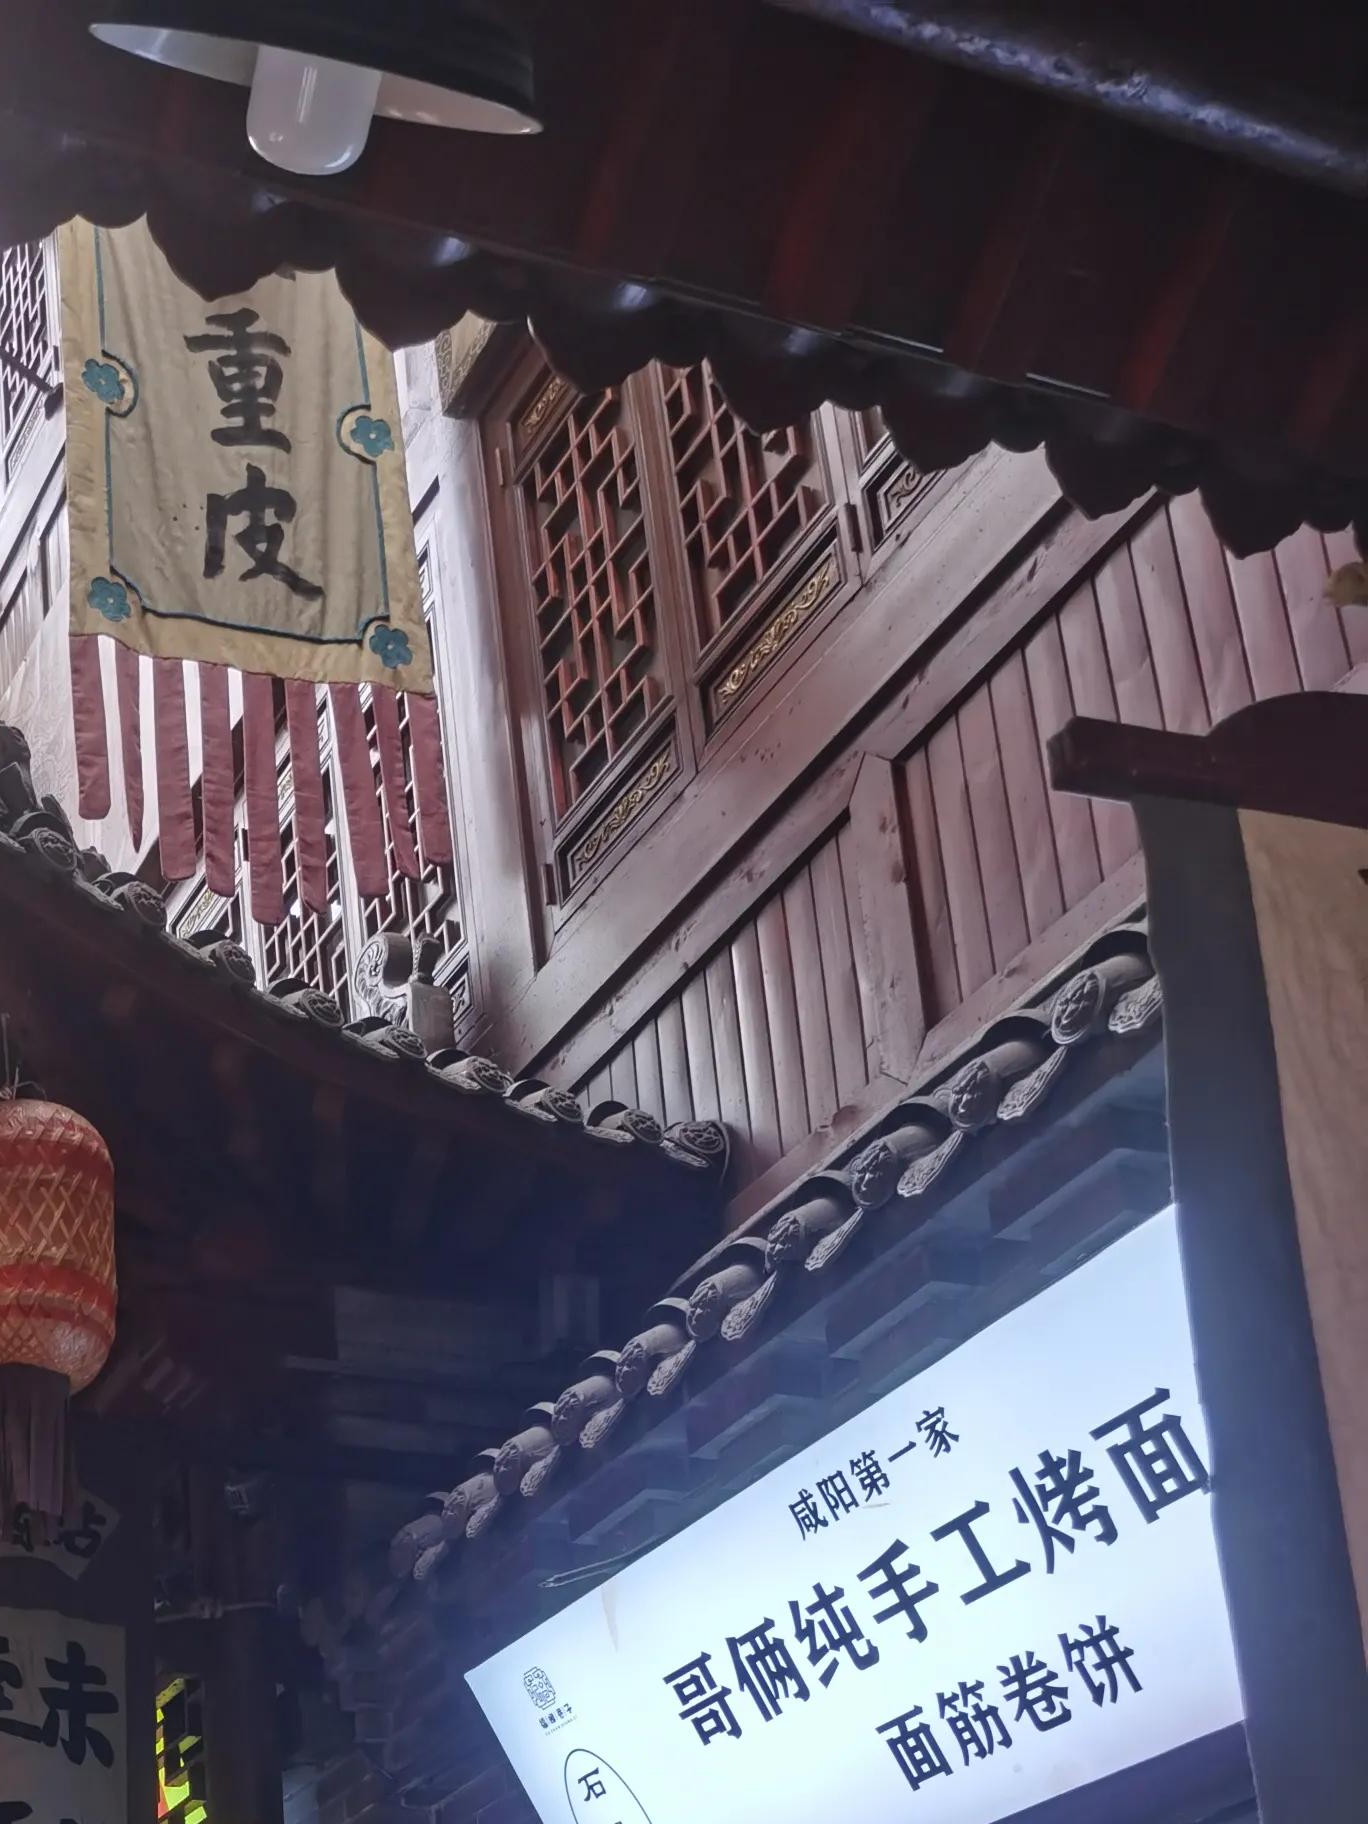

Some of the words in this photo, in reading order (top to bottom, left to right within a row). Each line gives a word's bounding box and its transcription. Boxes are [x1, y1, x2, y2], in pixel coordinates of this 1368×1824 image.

[183, 307, 325, 598] 重皮
[663, 1386, 1210, 1747] 哥俩纯手工烤面
[788, 1405, 961, 1541] 咸阳第一家
[875, 1615, 1145, 1792] 面筋卷饼
